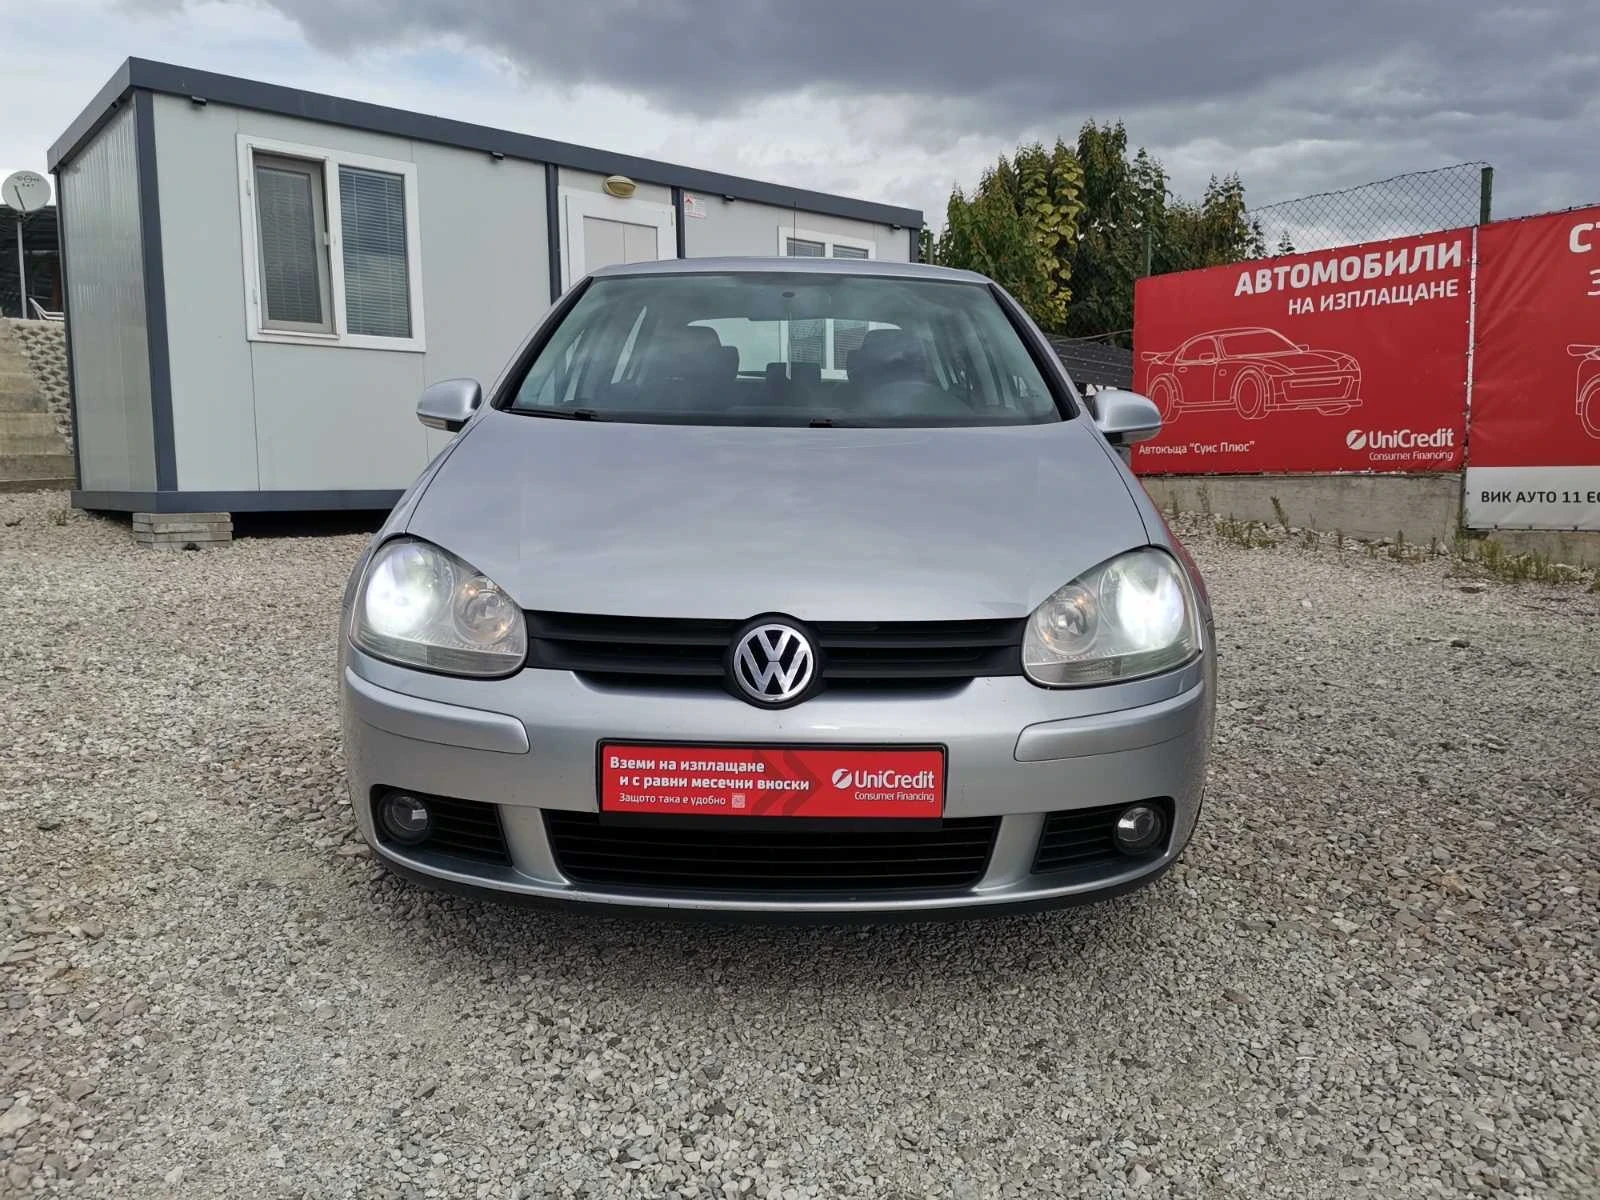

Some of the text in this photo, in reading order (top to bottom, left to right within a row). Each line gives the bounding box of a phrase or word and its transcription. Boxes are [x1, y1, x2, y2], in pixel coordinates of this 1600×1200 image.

[1569, 222, 1600, 253] С
[1234, 240, 1462, 297] АВТОМОБИЛИ
[1288, 279, 1459, 315] НА ИЗПЛАЩАНЕ
[1369, 428, 1454, 449] UniCredit
[1139, 444, 1187, 455] Автокъща
[1369, 450, 1454, 462] Consumer Financing
[1481, 490, 1511, 503] ВИК
[1515, 490, 1557, 503] АУТО
[1561, 490, 1582, 503] 11
[735, 625, 812, 701] VW
[609, 756, 765, 774] Вземи на изплащане
[619, 776, 810, 790] и с равни месечни вноски
[855, 770, 935, 789] UniCredit
[619, 792, 726, 806] Защото така е удобно
[854, 791, 935, 803] Consumer Financing
